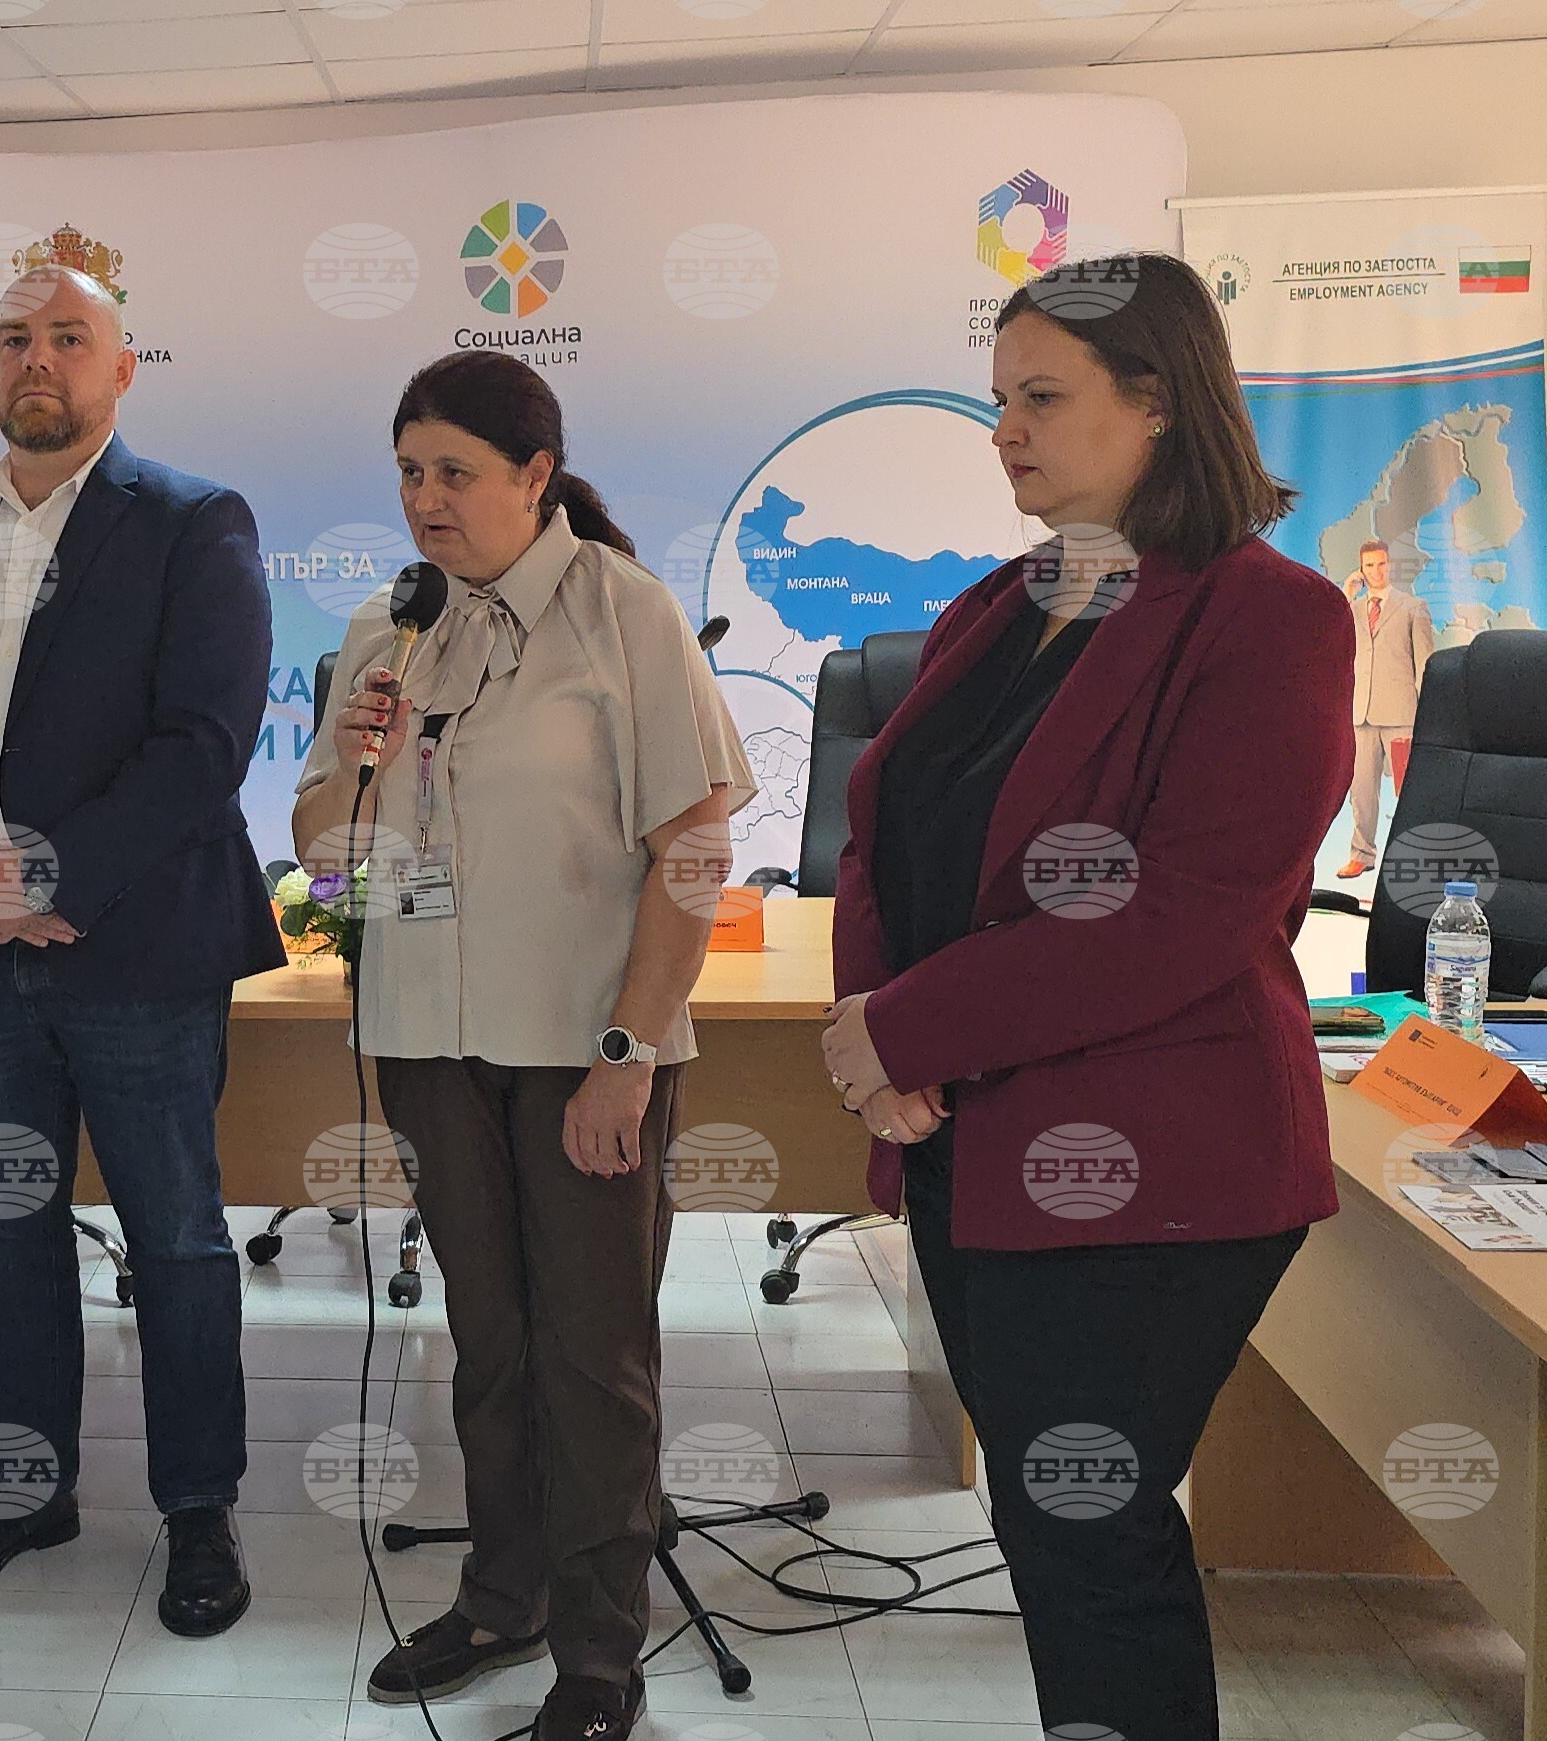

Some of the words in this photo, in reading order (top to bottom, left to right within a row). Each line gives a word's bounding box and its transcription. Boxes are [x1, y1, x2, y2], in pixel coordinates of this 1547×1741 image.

[1282, 261, 1340, 277] АГЕНЦИЯ
[1343, 260, 1362, 274] ПО
[1365, 257, 1437, 272] ЗАЕТОСТТА
[1289, 284, 1374, 301] EMPLOYMENT
[1376, 283, 1429, 297] AGENCY
[969, 298, 999, 312] ПРО
[968, 316, 991, 330] СО
[454, 326, 582, 349] Социална
[968, 334, 995, 348] ПРЕ
[136, 350, 173, 363] НАТА
[520, 350, 578, 367] ация
[753, 547, 797, 560] ВИДИН
[263, 551, 328, 580] НТЪР
[338, 551, 377, 579] ЗА
[786, 576, 849, 590] МОНТАНА
[850, 592, 892, 606] ВРАЦА
[923, 599, 954, 612] ПЛЕ
[795, 674, 818, 683] ЮГО
